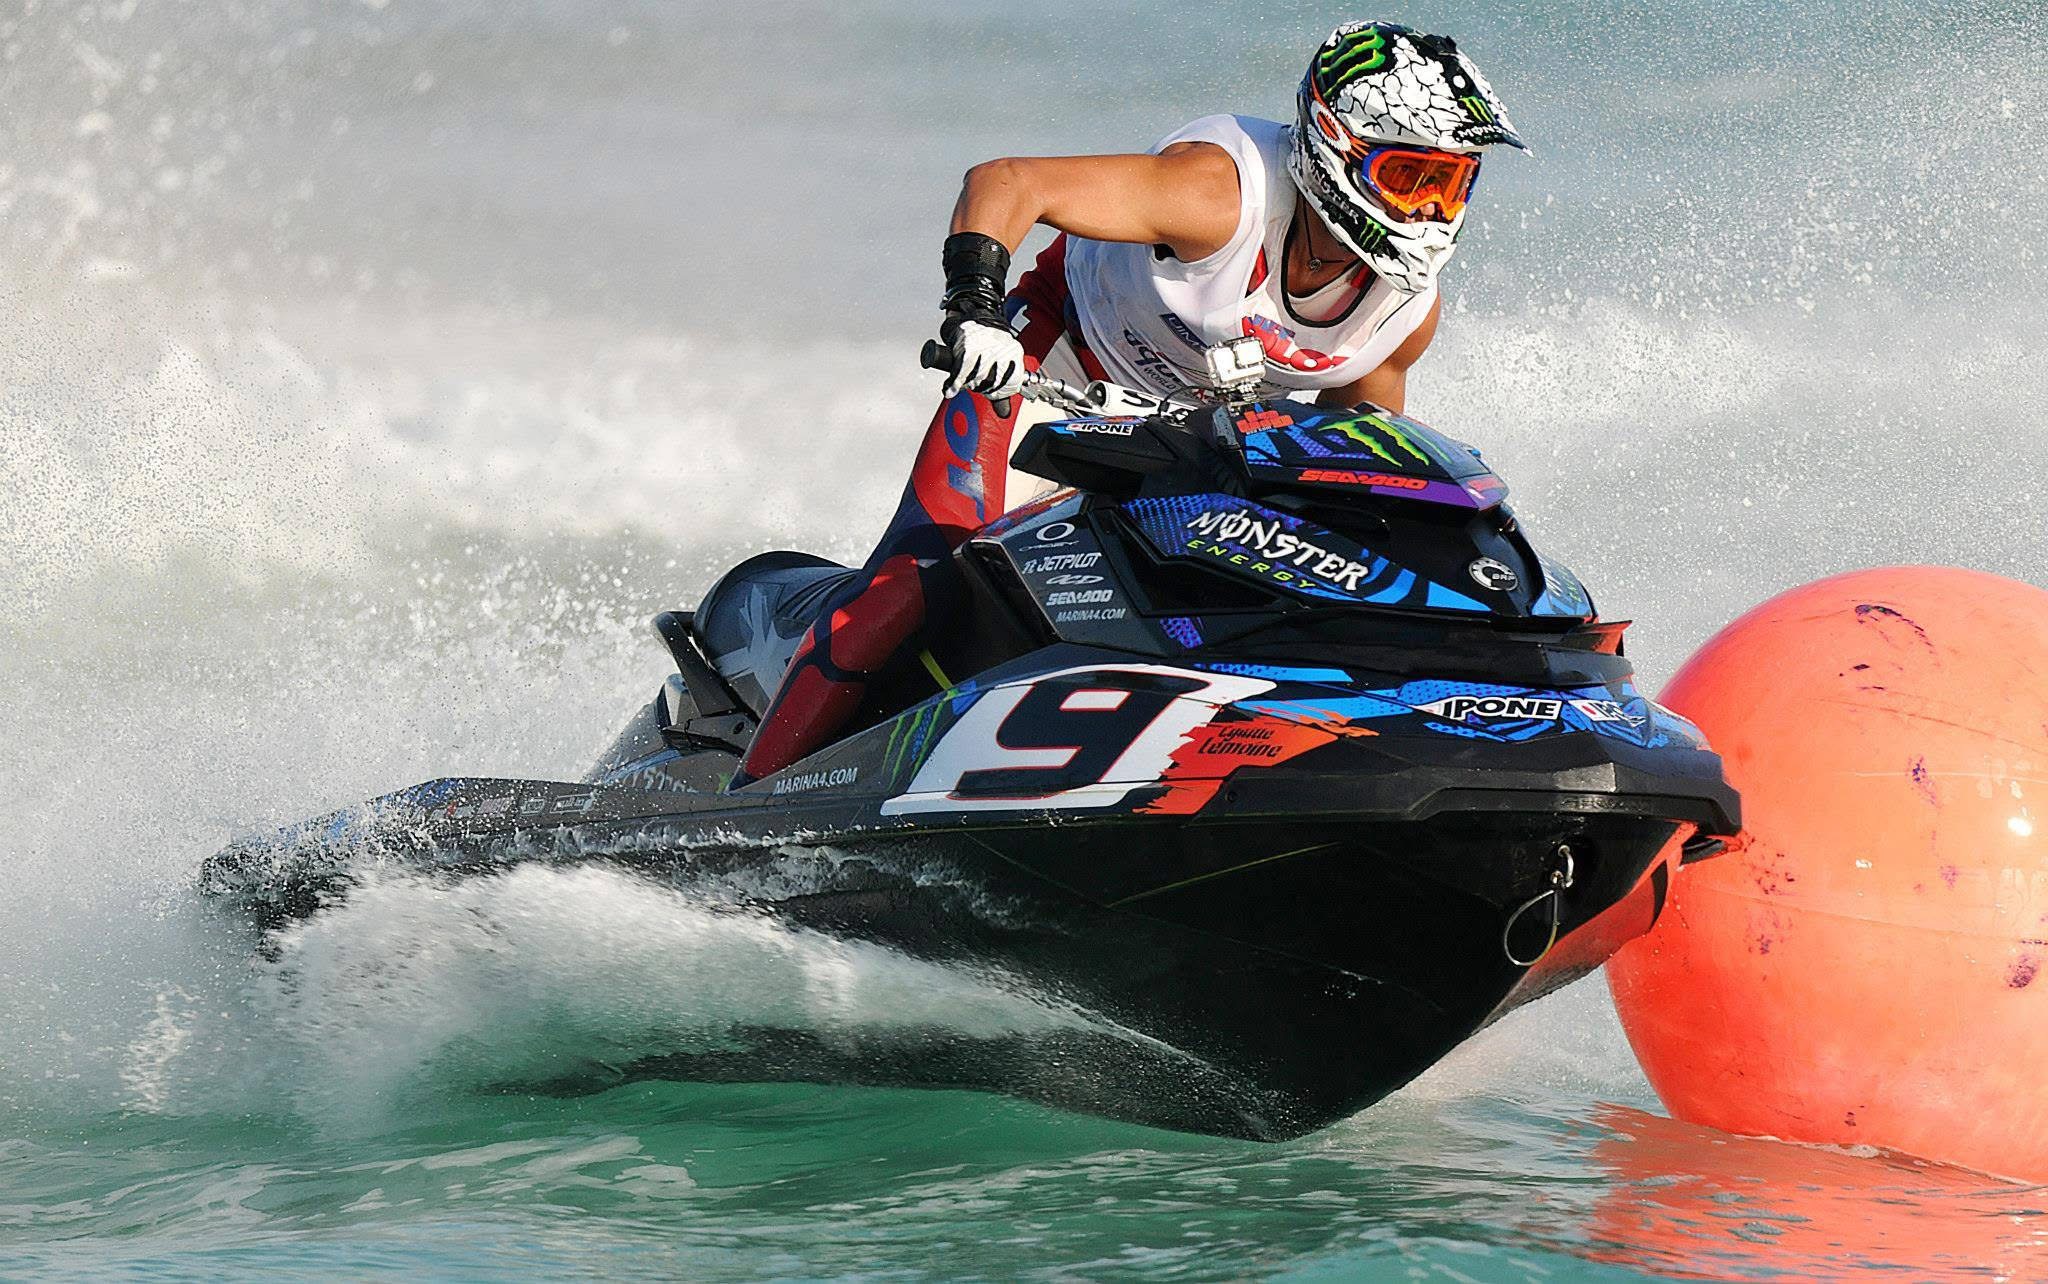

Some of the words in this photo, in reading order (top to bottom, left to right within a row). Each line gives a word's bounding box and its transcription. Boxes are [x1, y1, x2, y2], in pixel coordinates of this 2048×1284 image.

[1143, 367, 1177, 391] WORLD
[1080, 423, 1133, 436] IPONE
[1037, 551, 1102, 573] JETPILOT
[1187, 539, 1316, 588] ENERGY
[1492, 573, 1517, 583] BRP
[1055, 608, 1127, 623] MARINA4.COM
[1442, 697, 1559, 720] IPONE
[947, 669, 1213, 800] 9
[1198, 737, 1284, 758] Lemoine
[772, 766, 859, 796] MARINA4.COM
